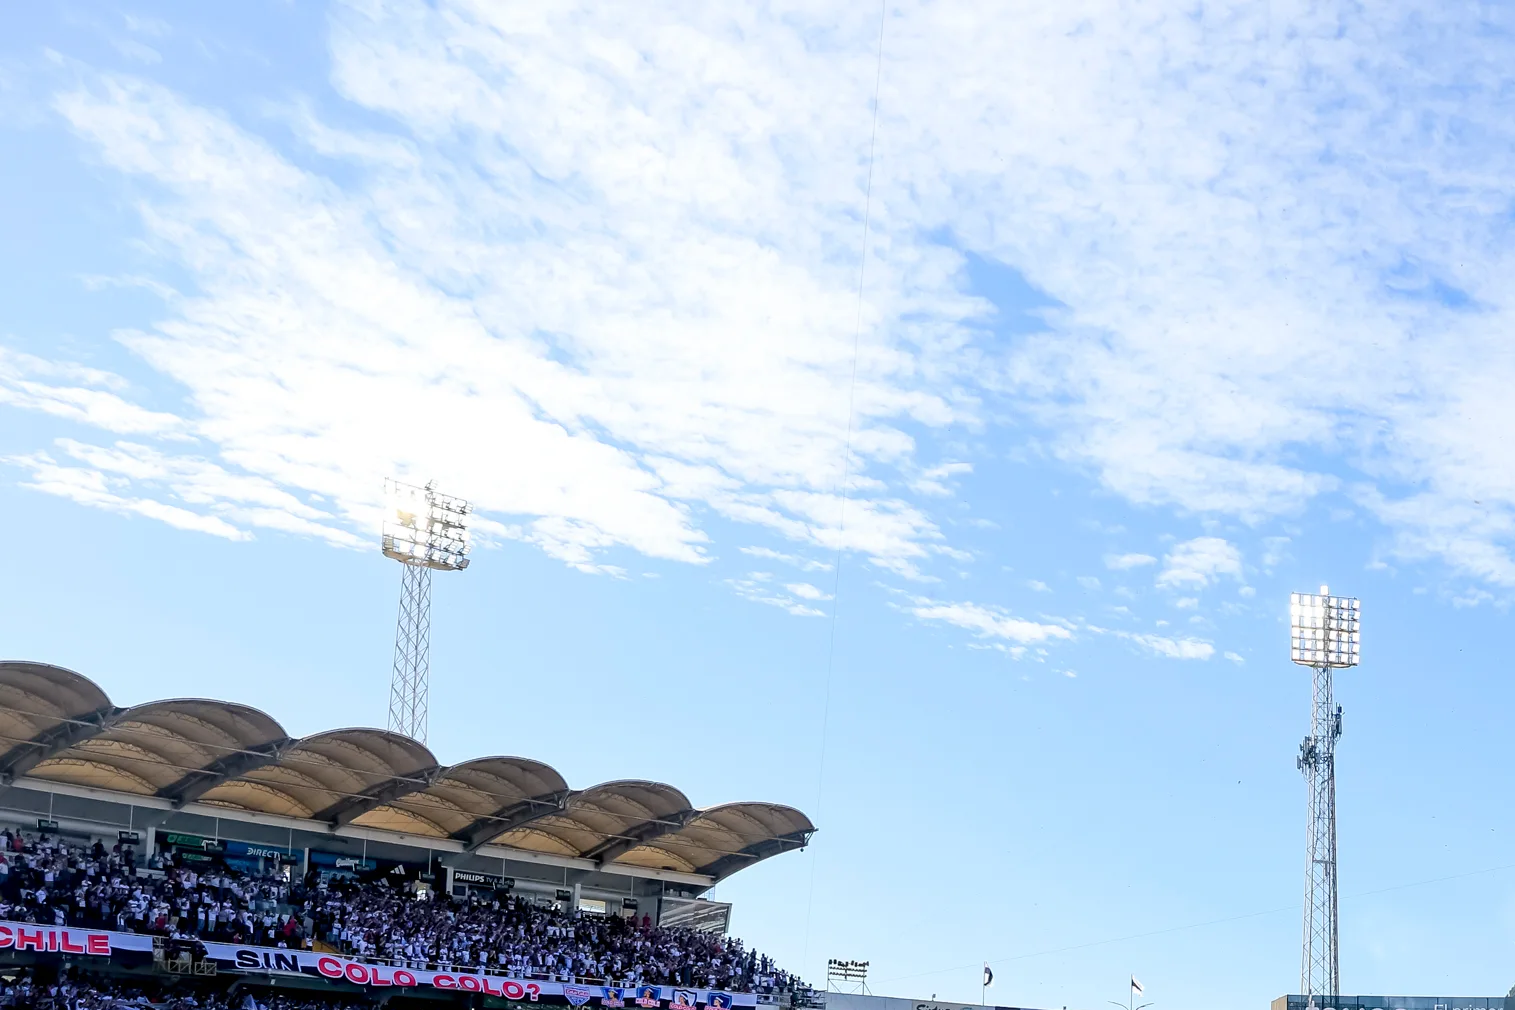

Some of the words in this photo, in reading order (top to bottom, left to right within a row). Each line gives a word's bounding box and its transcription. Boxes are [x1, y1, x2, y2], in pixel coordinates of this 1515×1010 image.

[455, 872, 485, 883] PHILIPS
[235, 949, 301, 973] SIN
[318, 957, 418, 987] COLO
[432, 974, 541, 1002] COLO?
